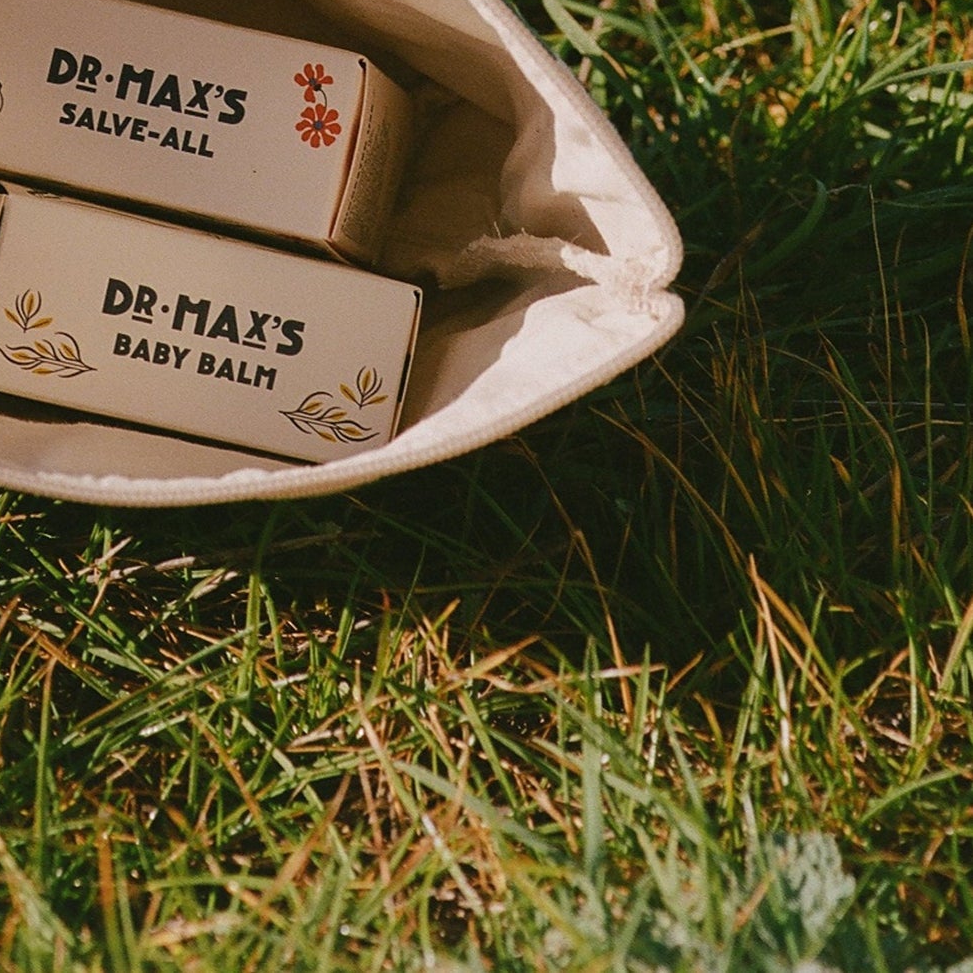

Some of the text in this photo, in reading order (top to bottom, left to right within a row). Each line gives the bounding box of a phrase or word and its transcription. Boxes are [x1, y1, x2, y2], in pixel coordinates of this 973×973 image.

[59, 103, 214, 158] SALVE-ALL
[113, 333, 278, 390] BABY BALM
